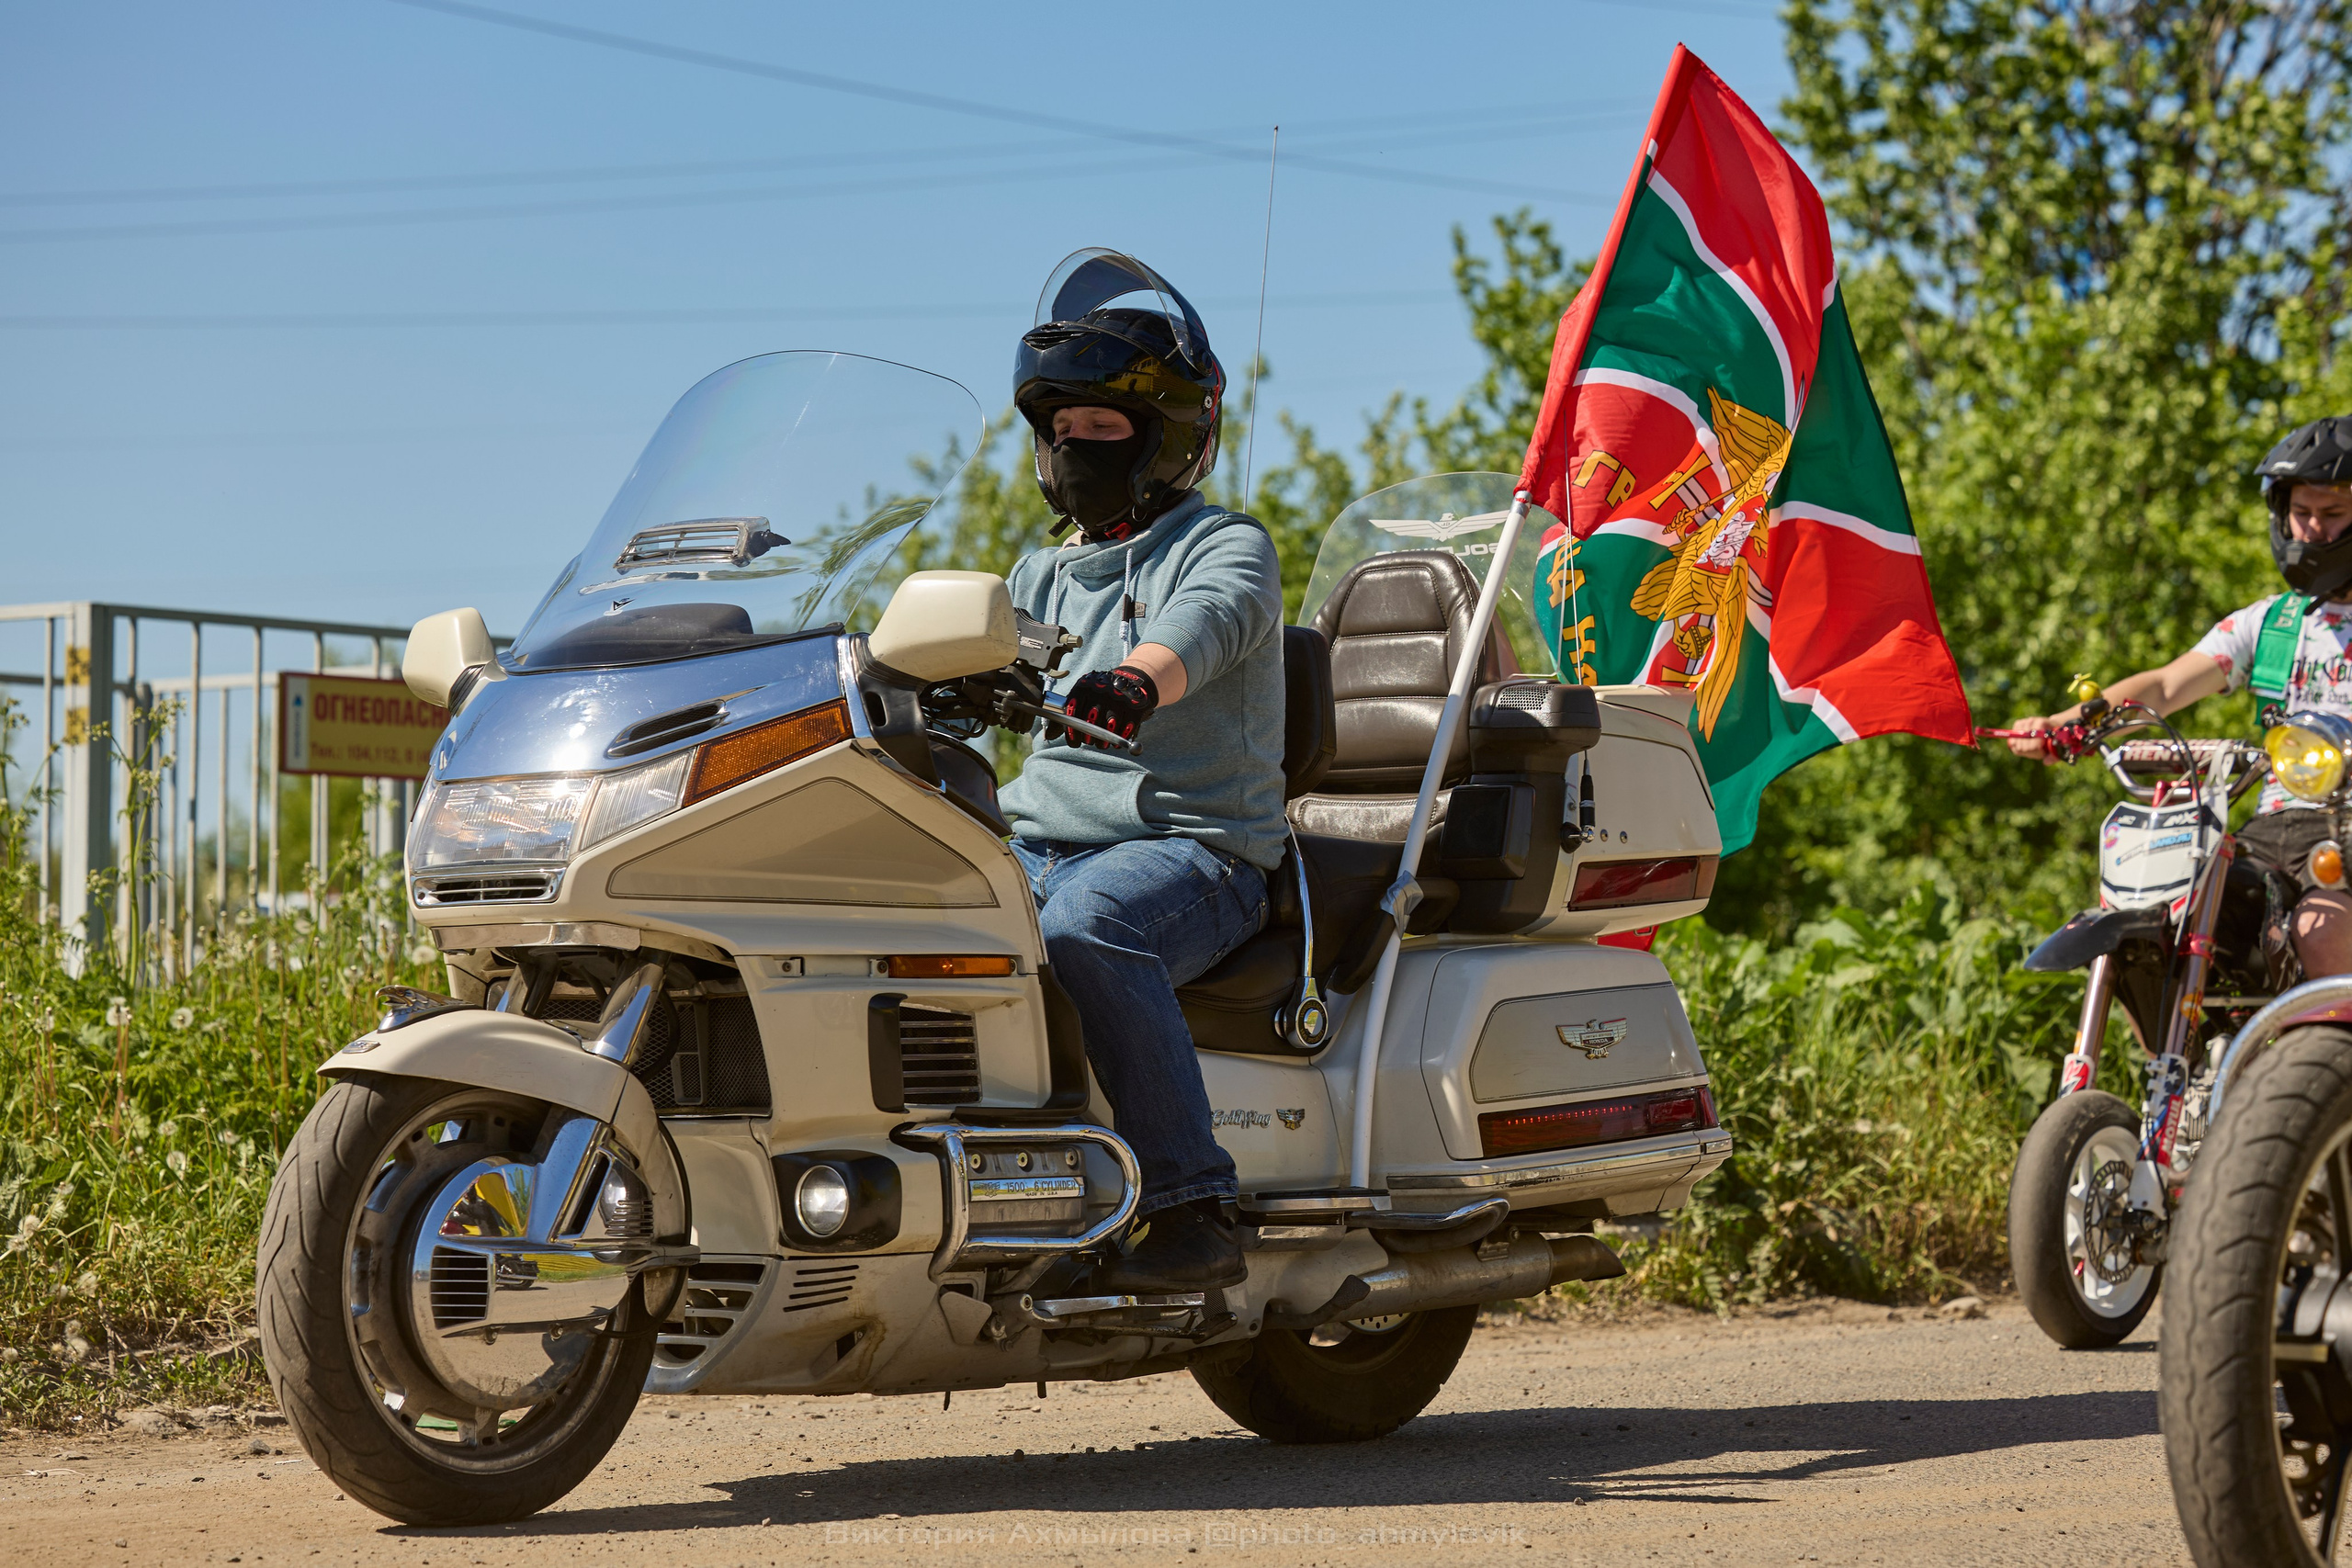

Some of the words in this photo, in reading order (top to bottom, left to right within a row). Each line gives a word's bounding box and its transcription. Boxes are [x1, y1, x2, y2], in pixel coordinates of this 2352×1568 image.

[313, 693, 447, 728] ОГНЕОПАСН
[2161, 1099, 2183, 1154] MOTUL
[1006, 1181, 1025, 1192] 1500
[1034, 1180, 1039, 1191] 6
[1041, 1179, 1077, 1191] CYLINDER
